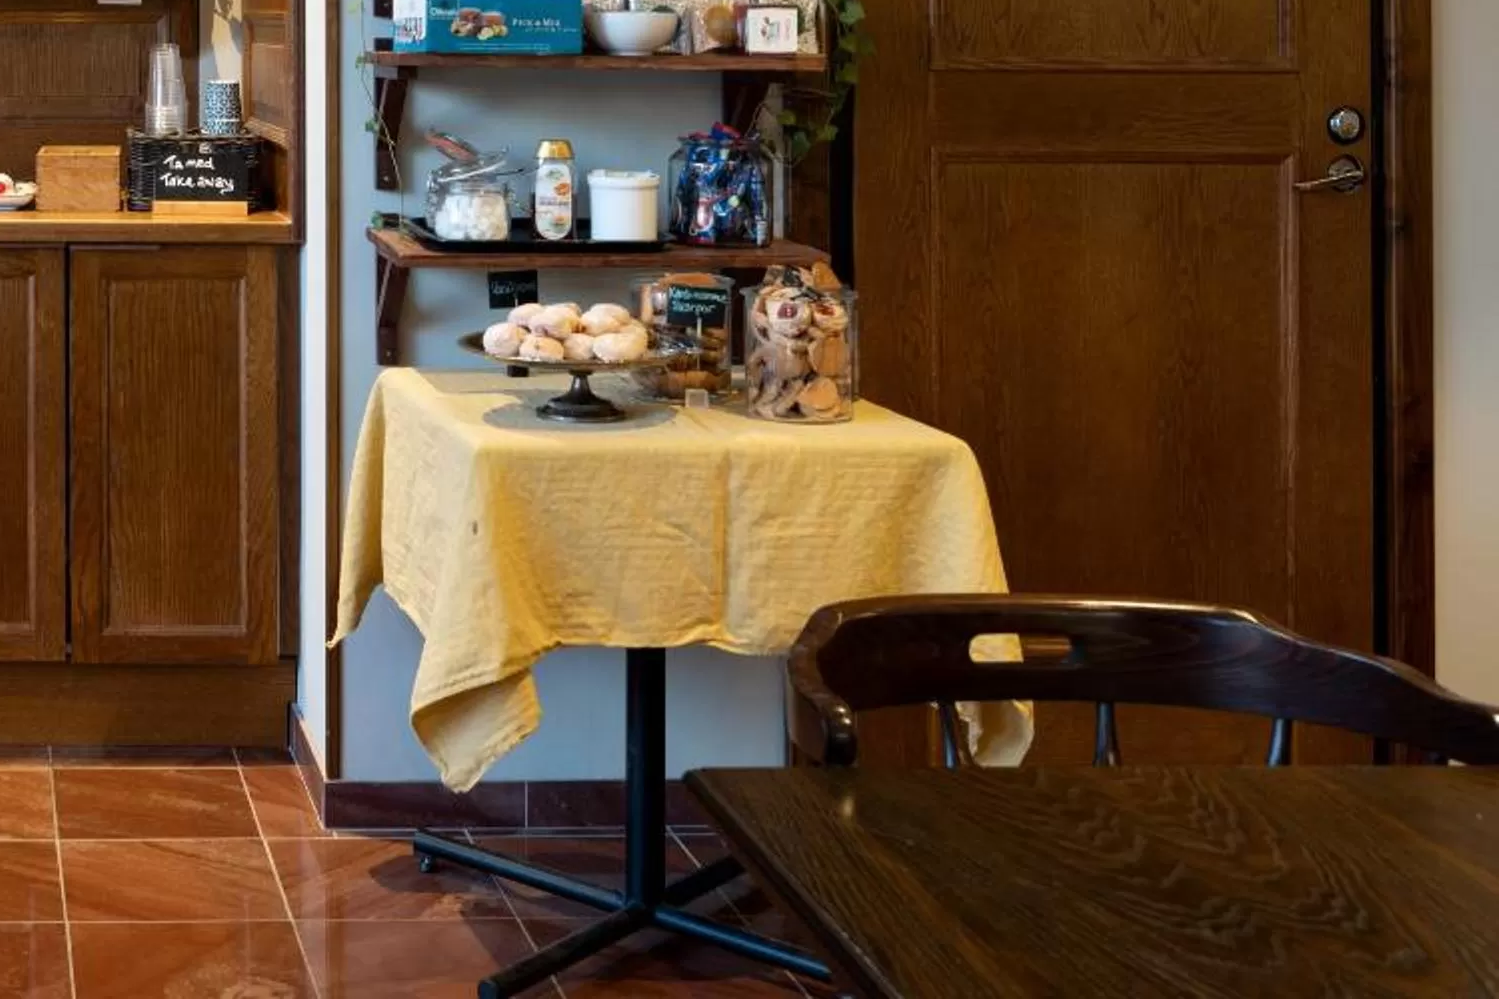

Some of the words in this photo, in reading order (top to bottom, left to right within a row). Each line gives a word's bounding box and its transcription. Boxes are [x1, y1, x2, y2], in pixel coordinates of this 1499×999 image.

[163, 154, 184, 170] Ta
[185, 157, 215, 170] med
[160, 172, 195, 188] Take
[197, 176, 234, 195] away
